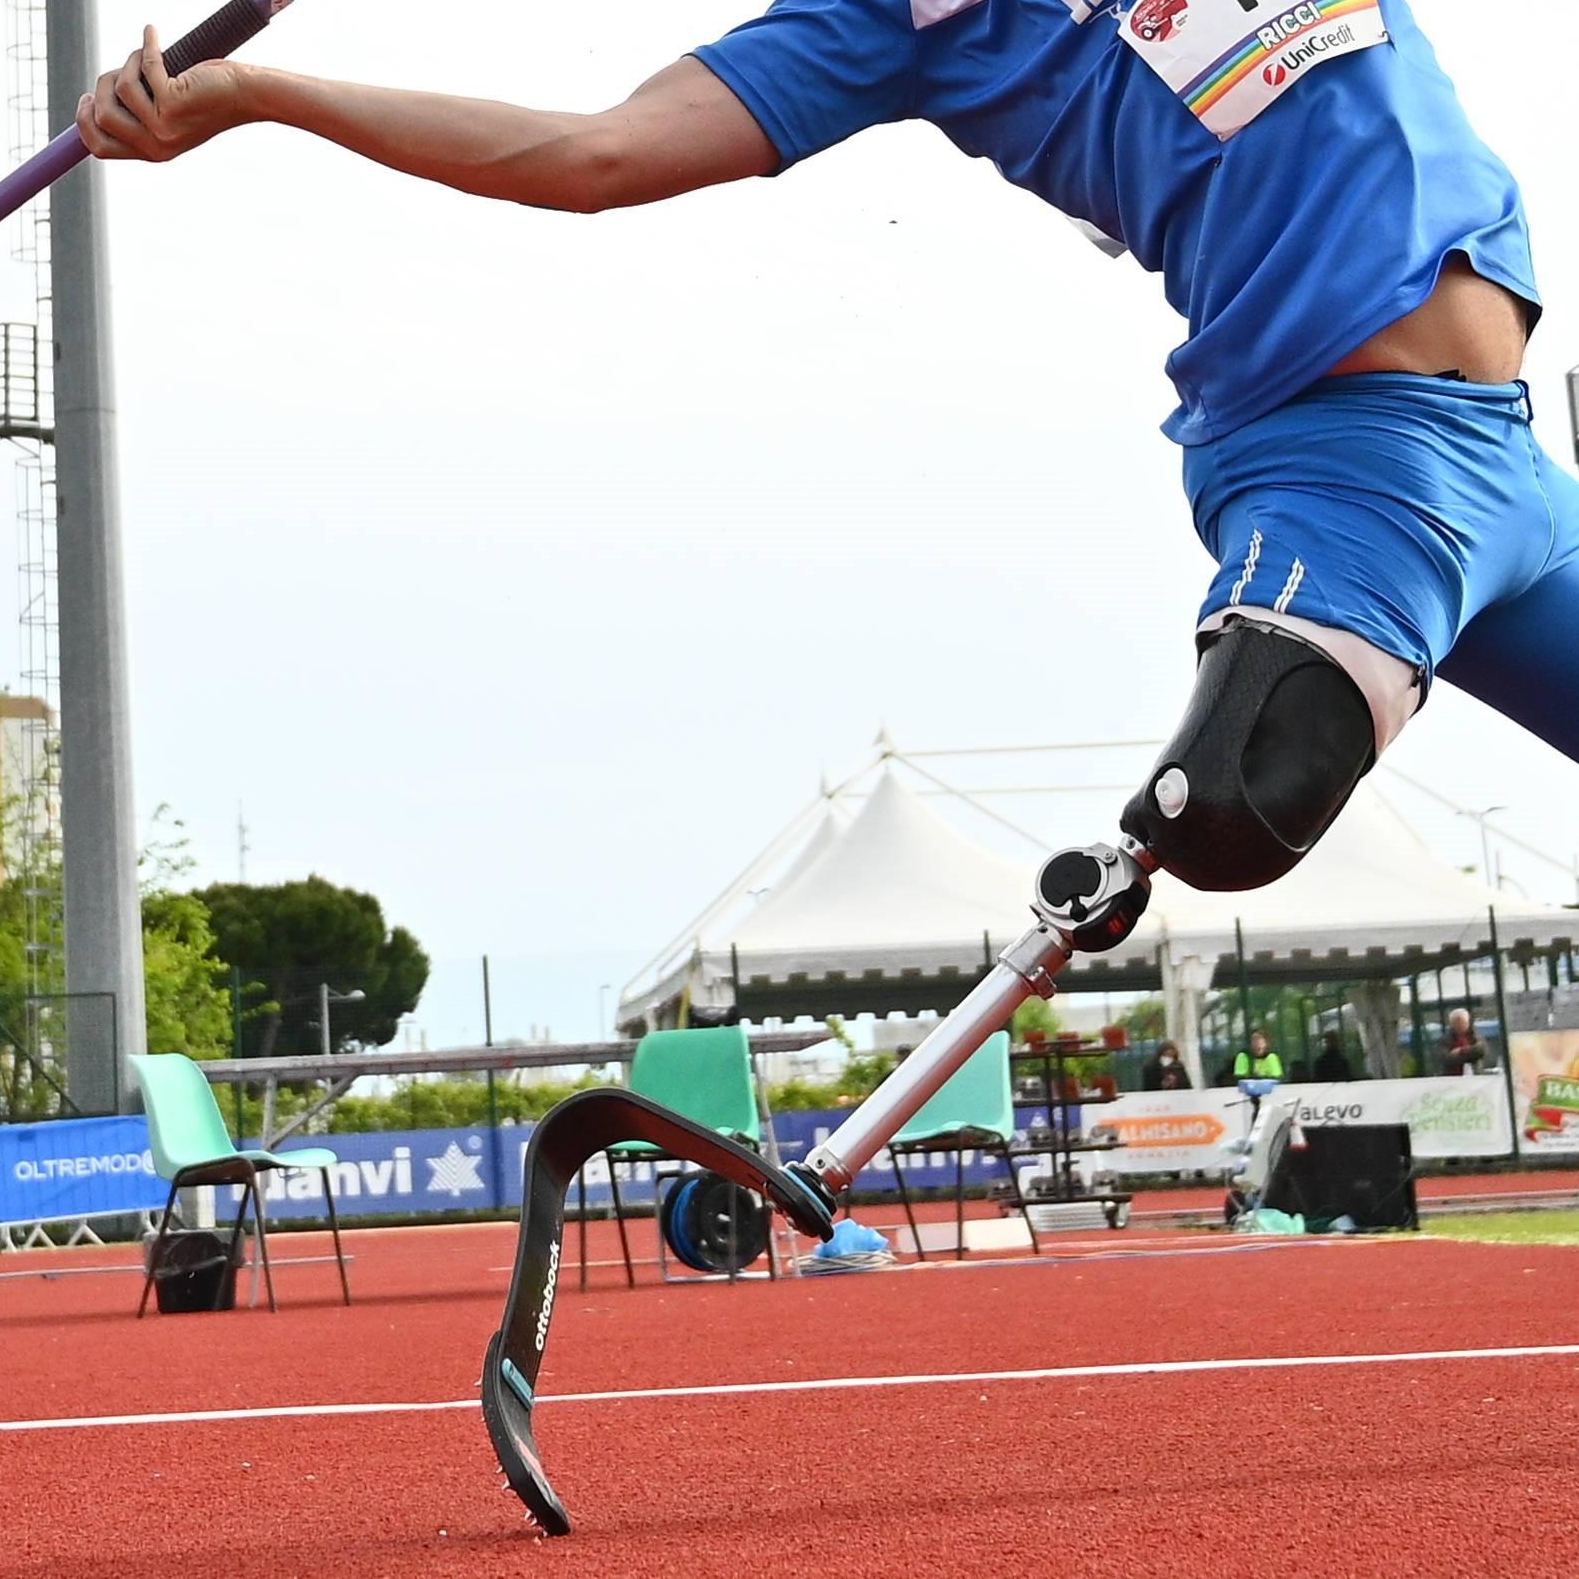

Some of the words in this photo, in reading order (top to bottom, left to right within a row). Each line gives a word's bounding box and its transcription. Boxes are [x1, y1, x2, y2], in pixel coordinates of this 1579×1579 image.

[1256, 2, 1321, 50] RICCI
[1281, 24, 1355, 70] UniCredit
[1118, 1121, 1207, 1140] ALMISANO
[535, 1240, 560, 1352] ottobock
